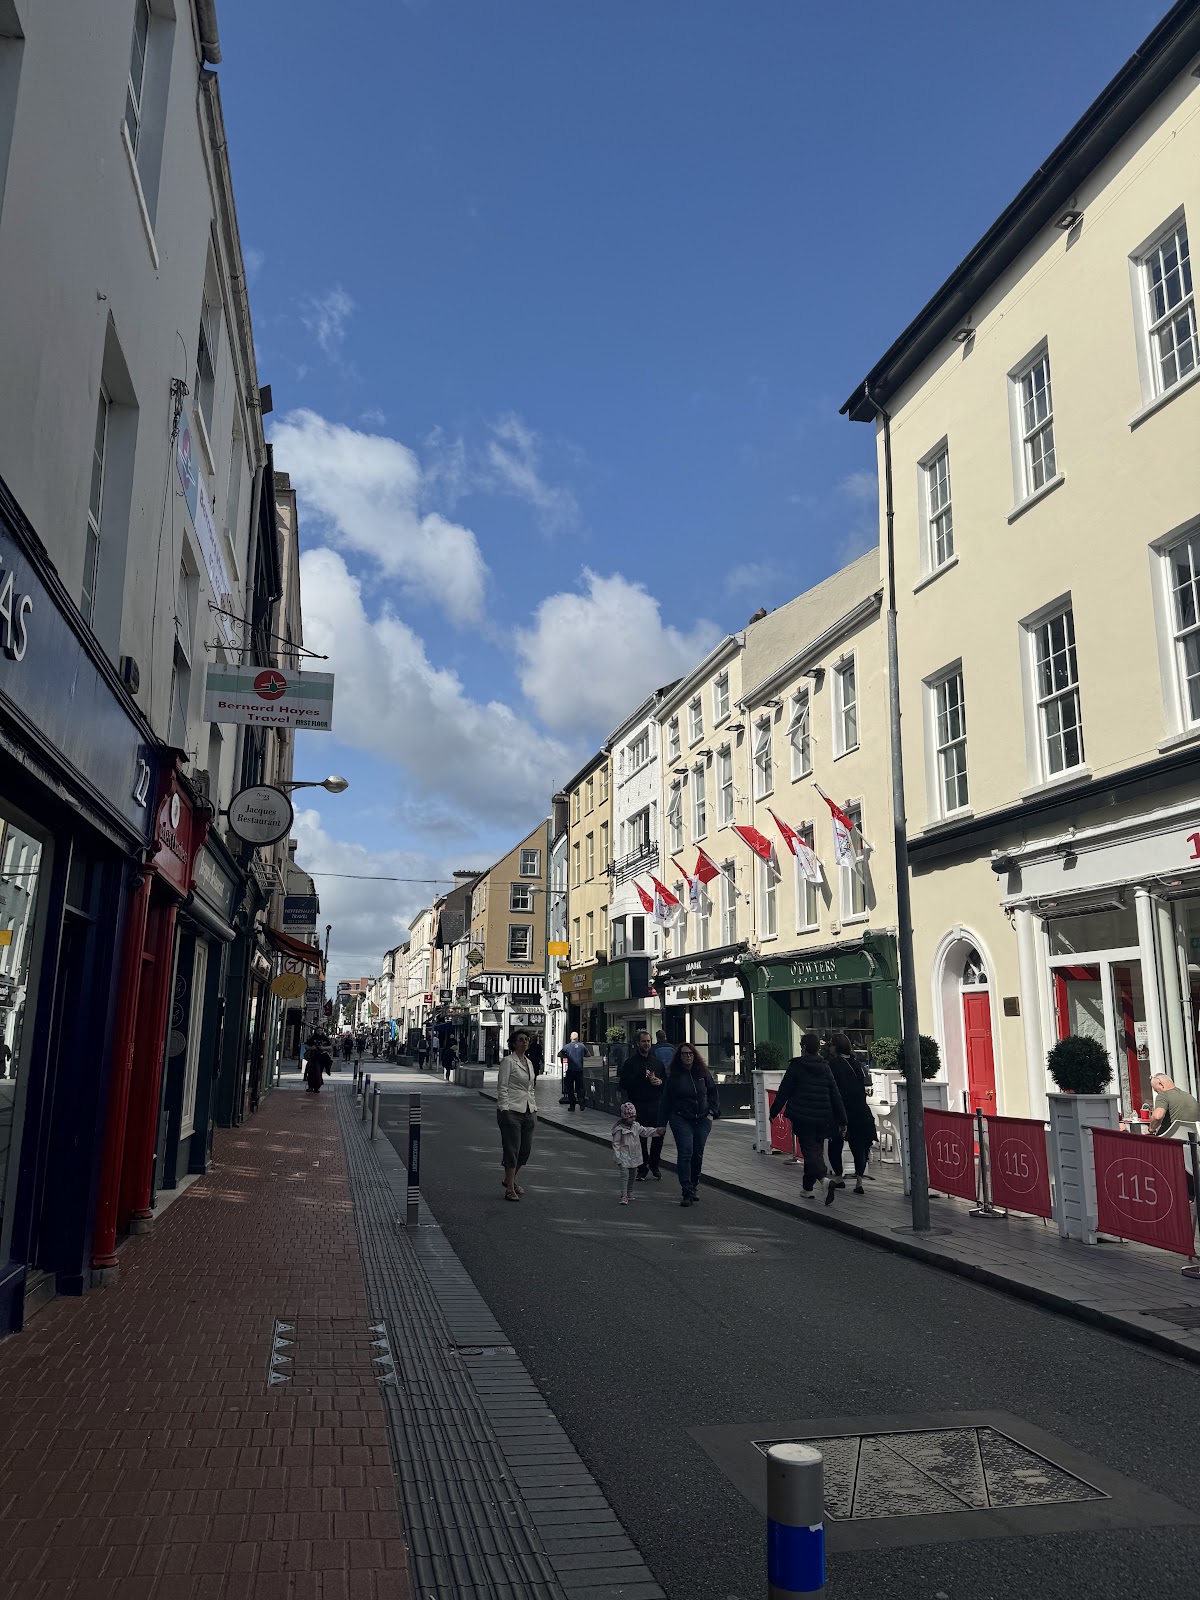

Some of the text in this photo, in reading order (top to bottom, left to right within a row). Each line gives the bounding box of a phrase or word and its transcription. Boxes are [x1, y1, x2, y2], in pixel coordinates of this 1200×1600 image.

[0, 555, 33, 661] AS
[218, 701, 320, 716] Bernard Hayes
[248, 713, 290, 723] Travel
[311, 720, 328, 728] FLOOR
[245, 804, 277, 816] Jacques
[237, 813, 281, 826] Restaurant
[790, 959, 836, 976] O'DWYERS
[936, 1140, 960, 1166] 115
[1004, 1151, 1029, 1178] 115
[1116, 1172, 1158, 1206] 115
